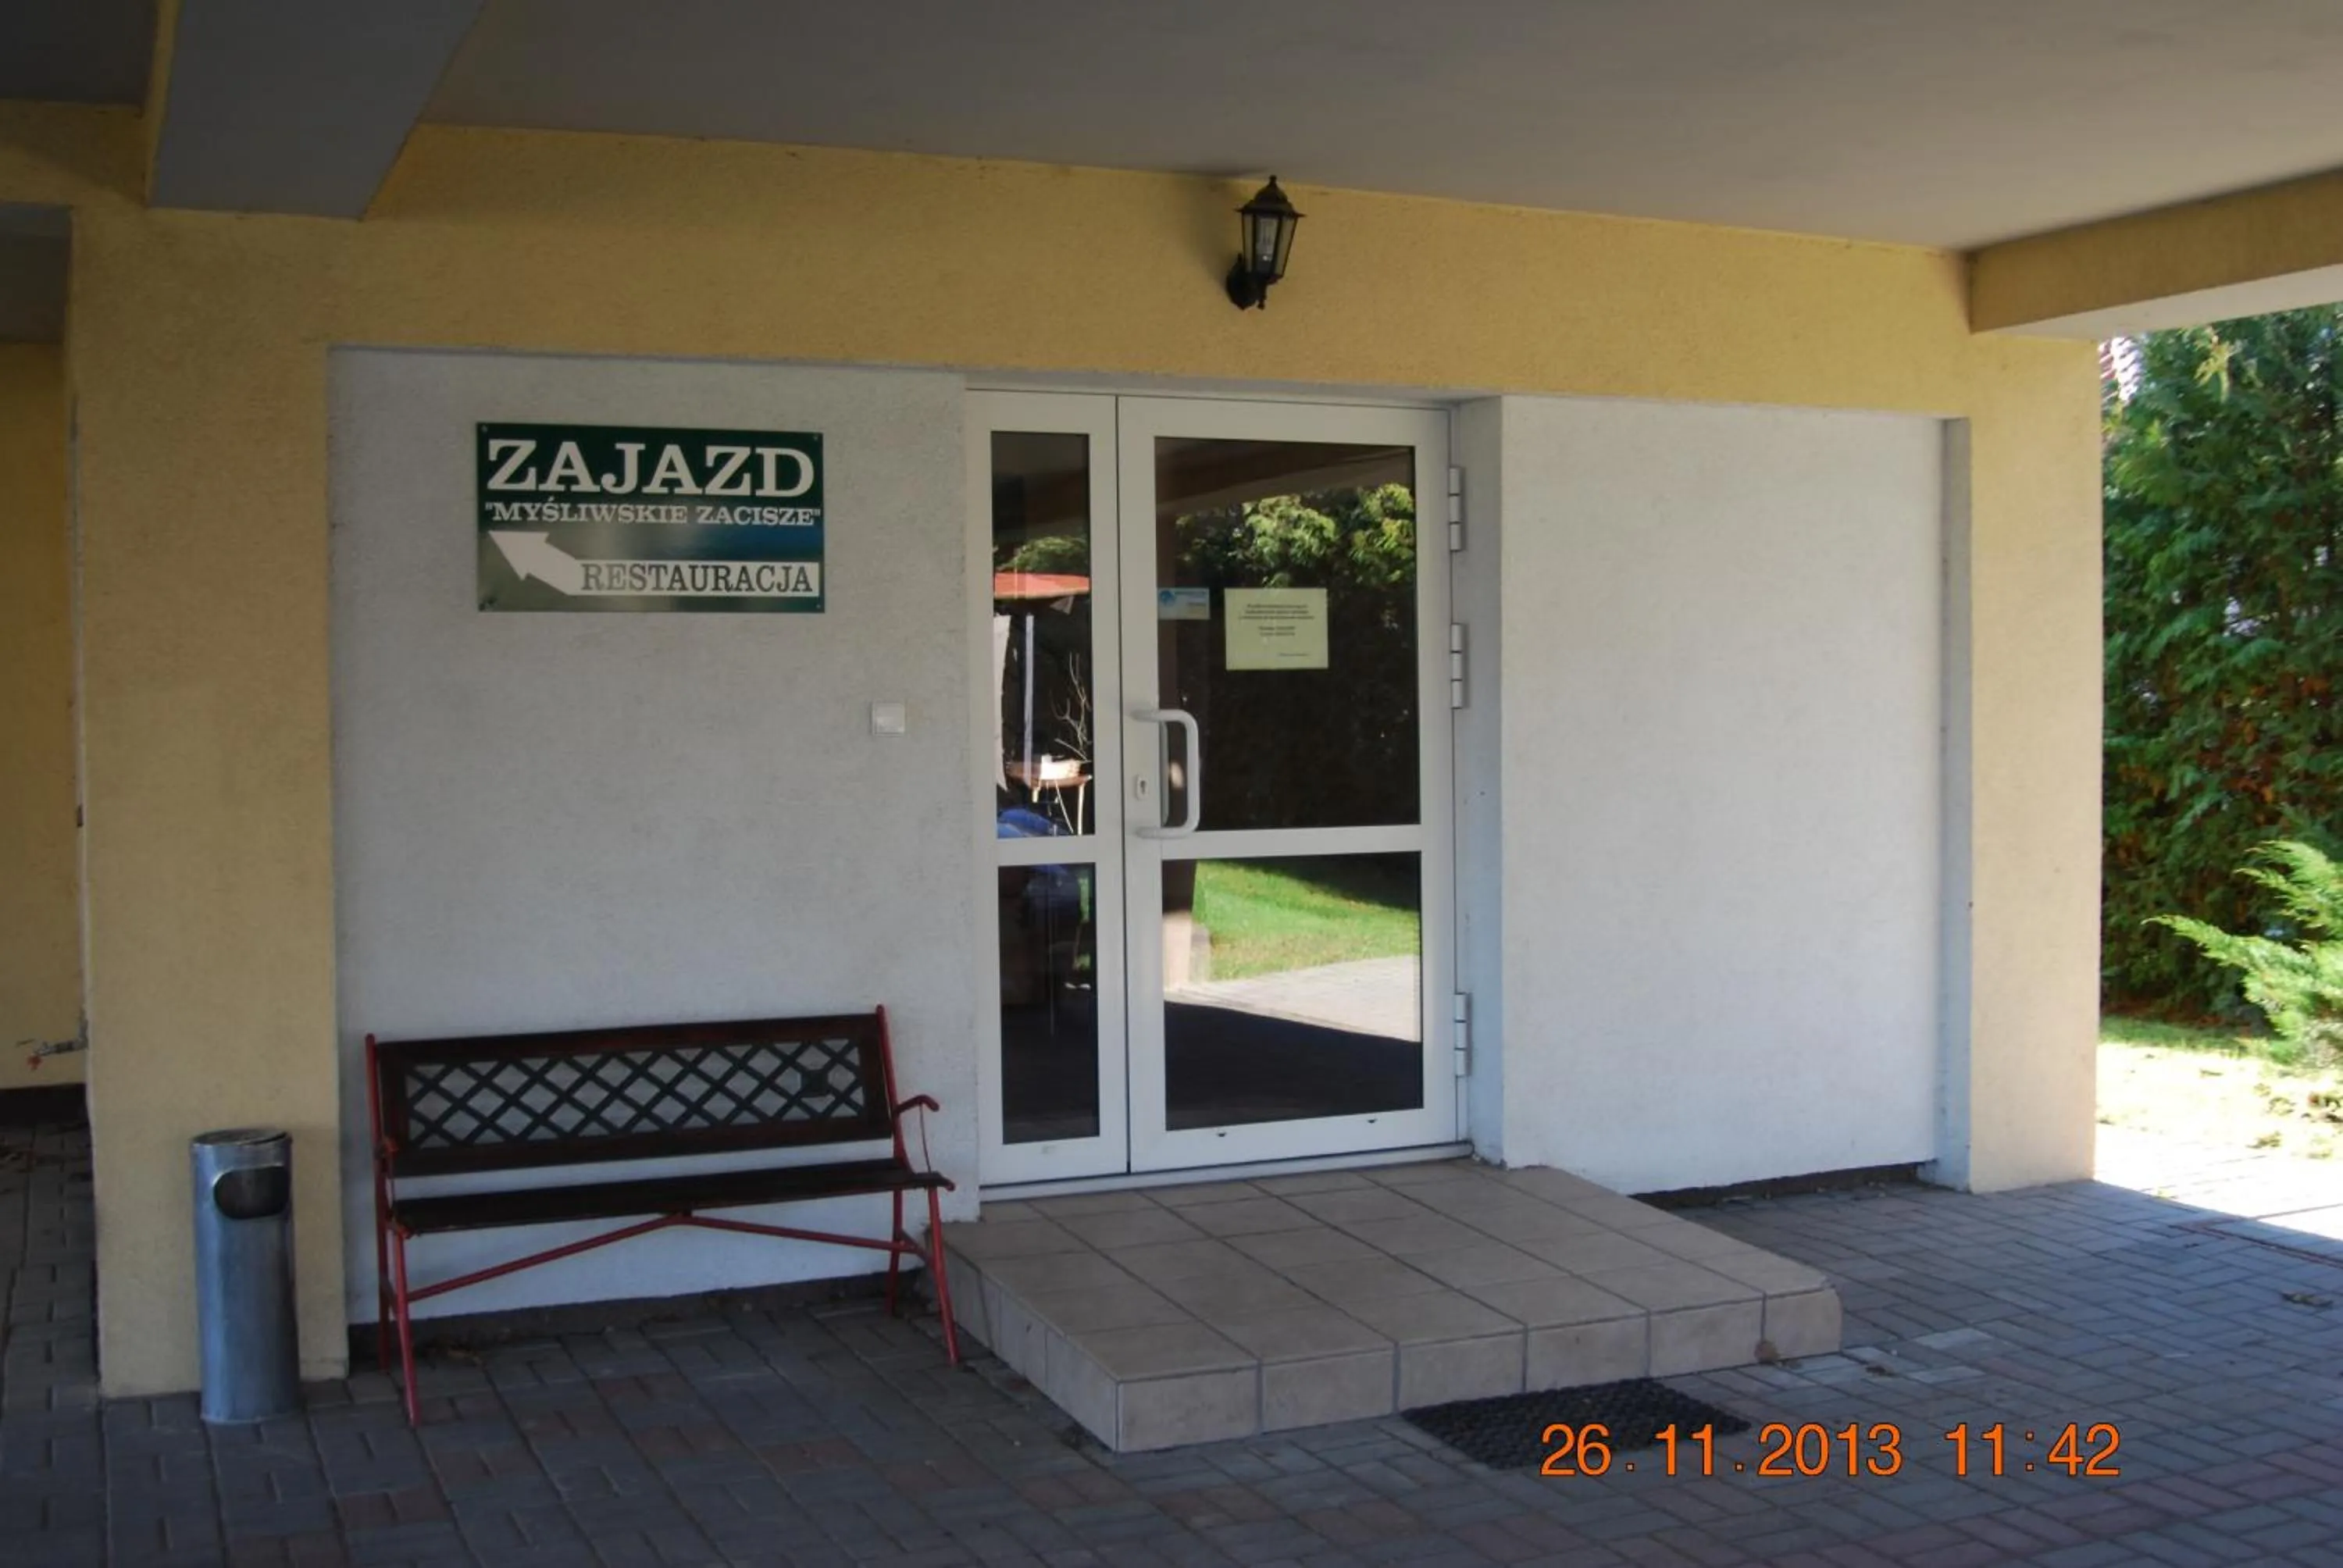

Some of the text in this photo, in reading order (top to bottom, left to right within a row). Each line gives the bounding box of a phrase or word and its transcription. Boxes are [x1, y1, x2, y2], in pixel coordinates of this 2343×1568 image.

[487, 439, 815, 497] ZAJAZD
[485, 497, 822, 527] "MYŚLIWSKIE ZACISZE"
[580, 563, 813, 593] RESTAURACJA
